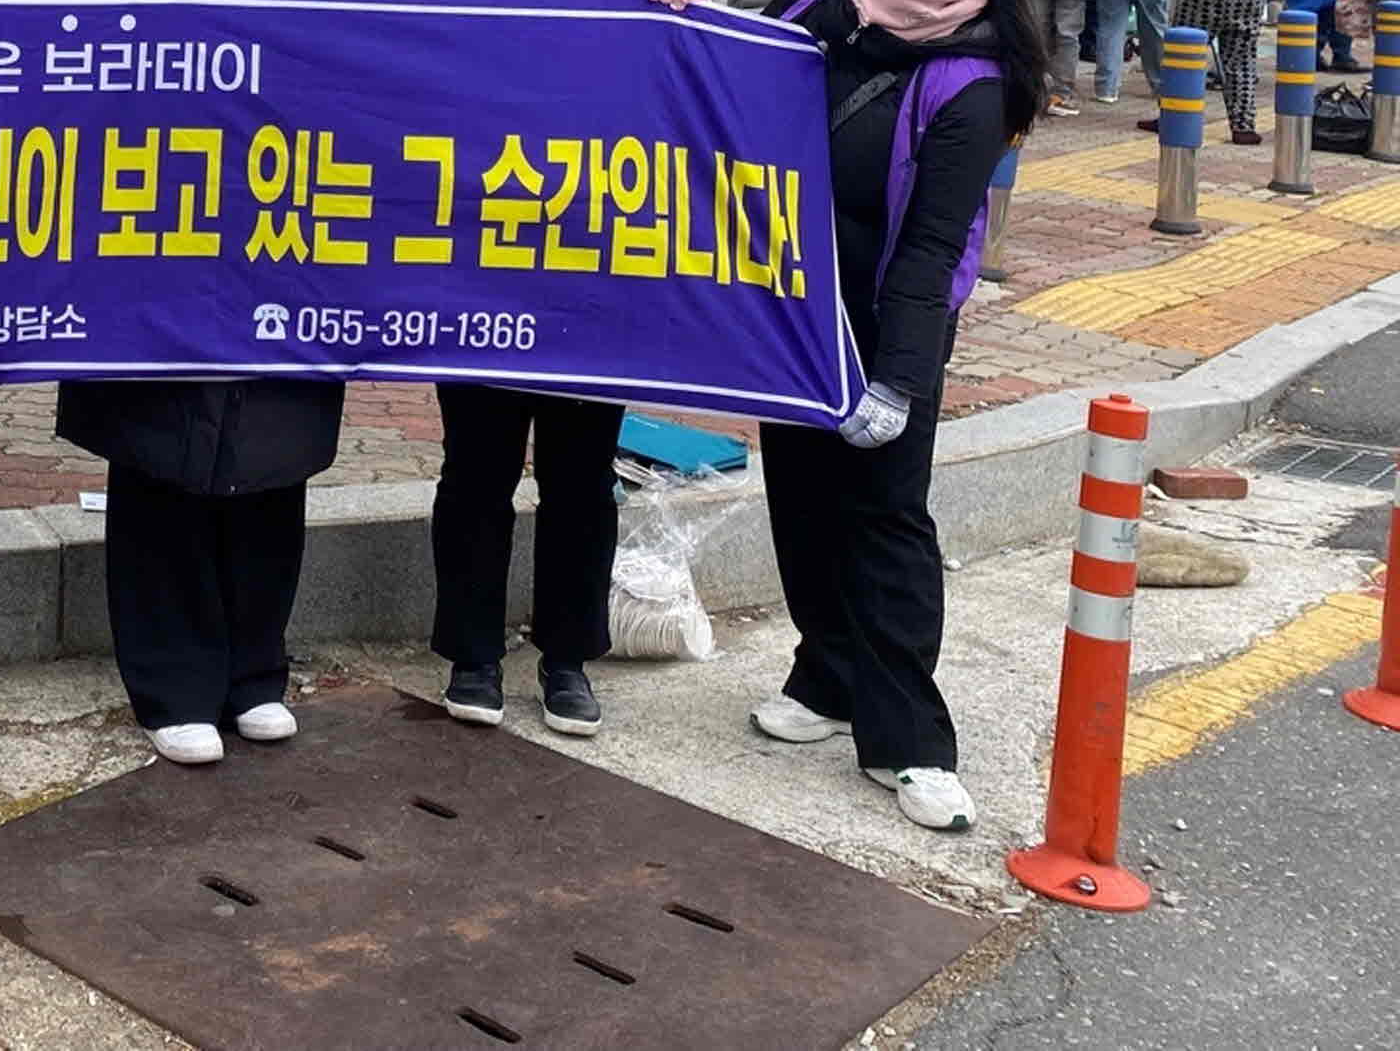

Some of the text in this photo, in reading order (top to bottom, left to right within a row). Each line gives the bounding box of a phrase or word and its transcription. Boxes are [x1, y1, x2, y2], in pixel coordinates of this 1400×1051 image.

[42, 42, 261, 95] 보라데이
[98, 127, 224, 257] 보고
[245, 123, 374, 266] 있는
[393, 135, 456, 265] 그
[479, 134, 807, 300] 순간입니다!
[296, 306, 536, 350] 055-391-1366
